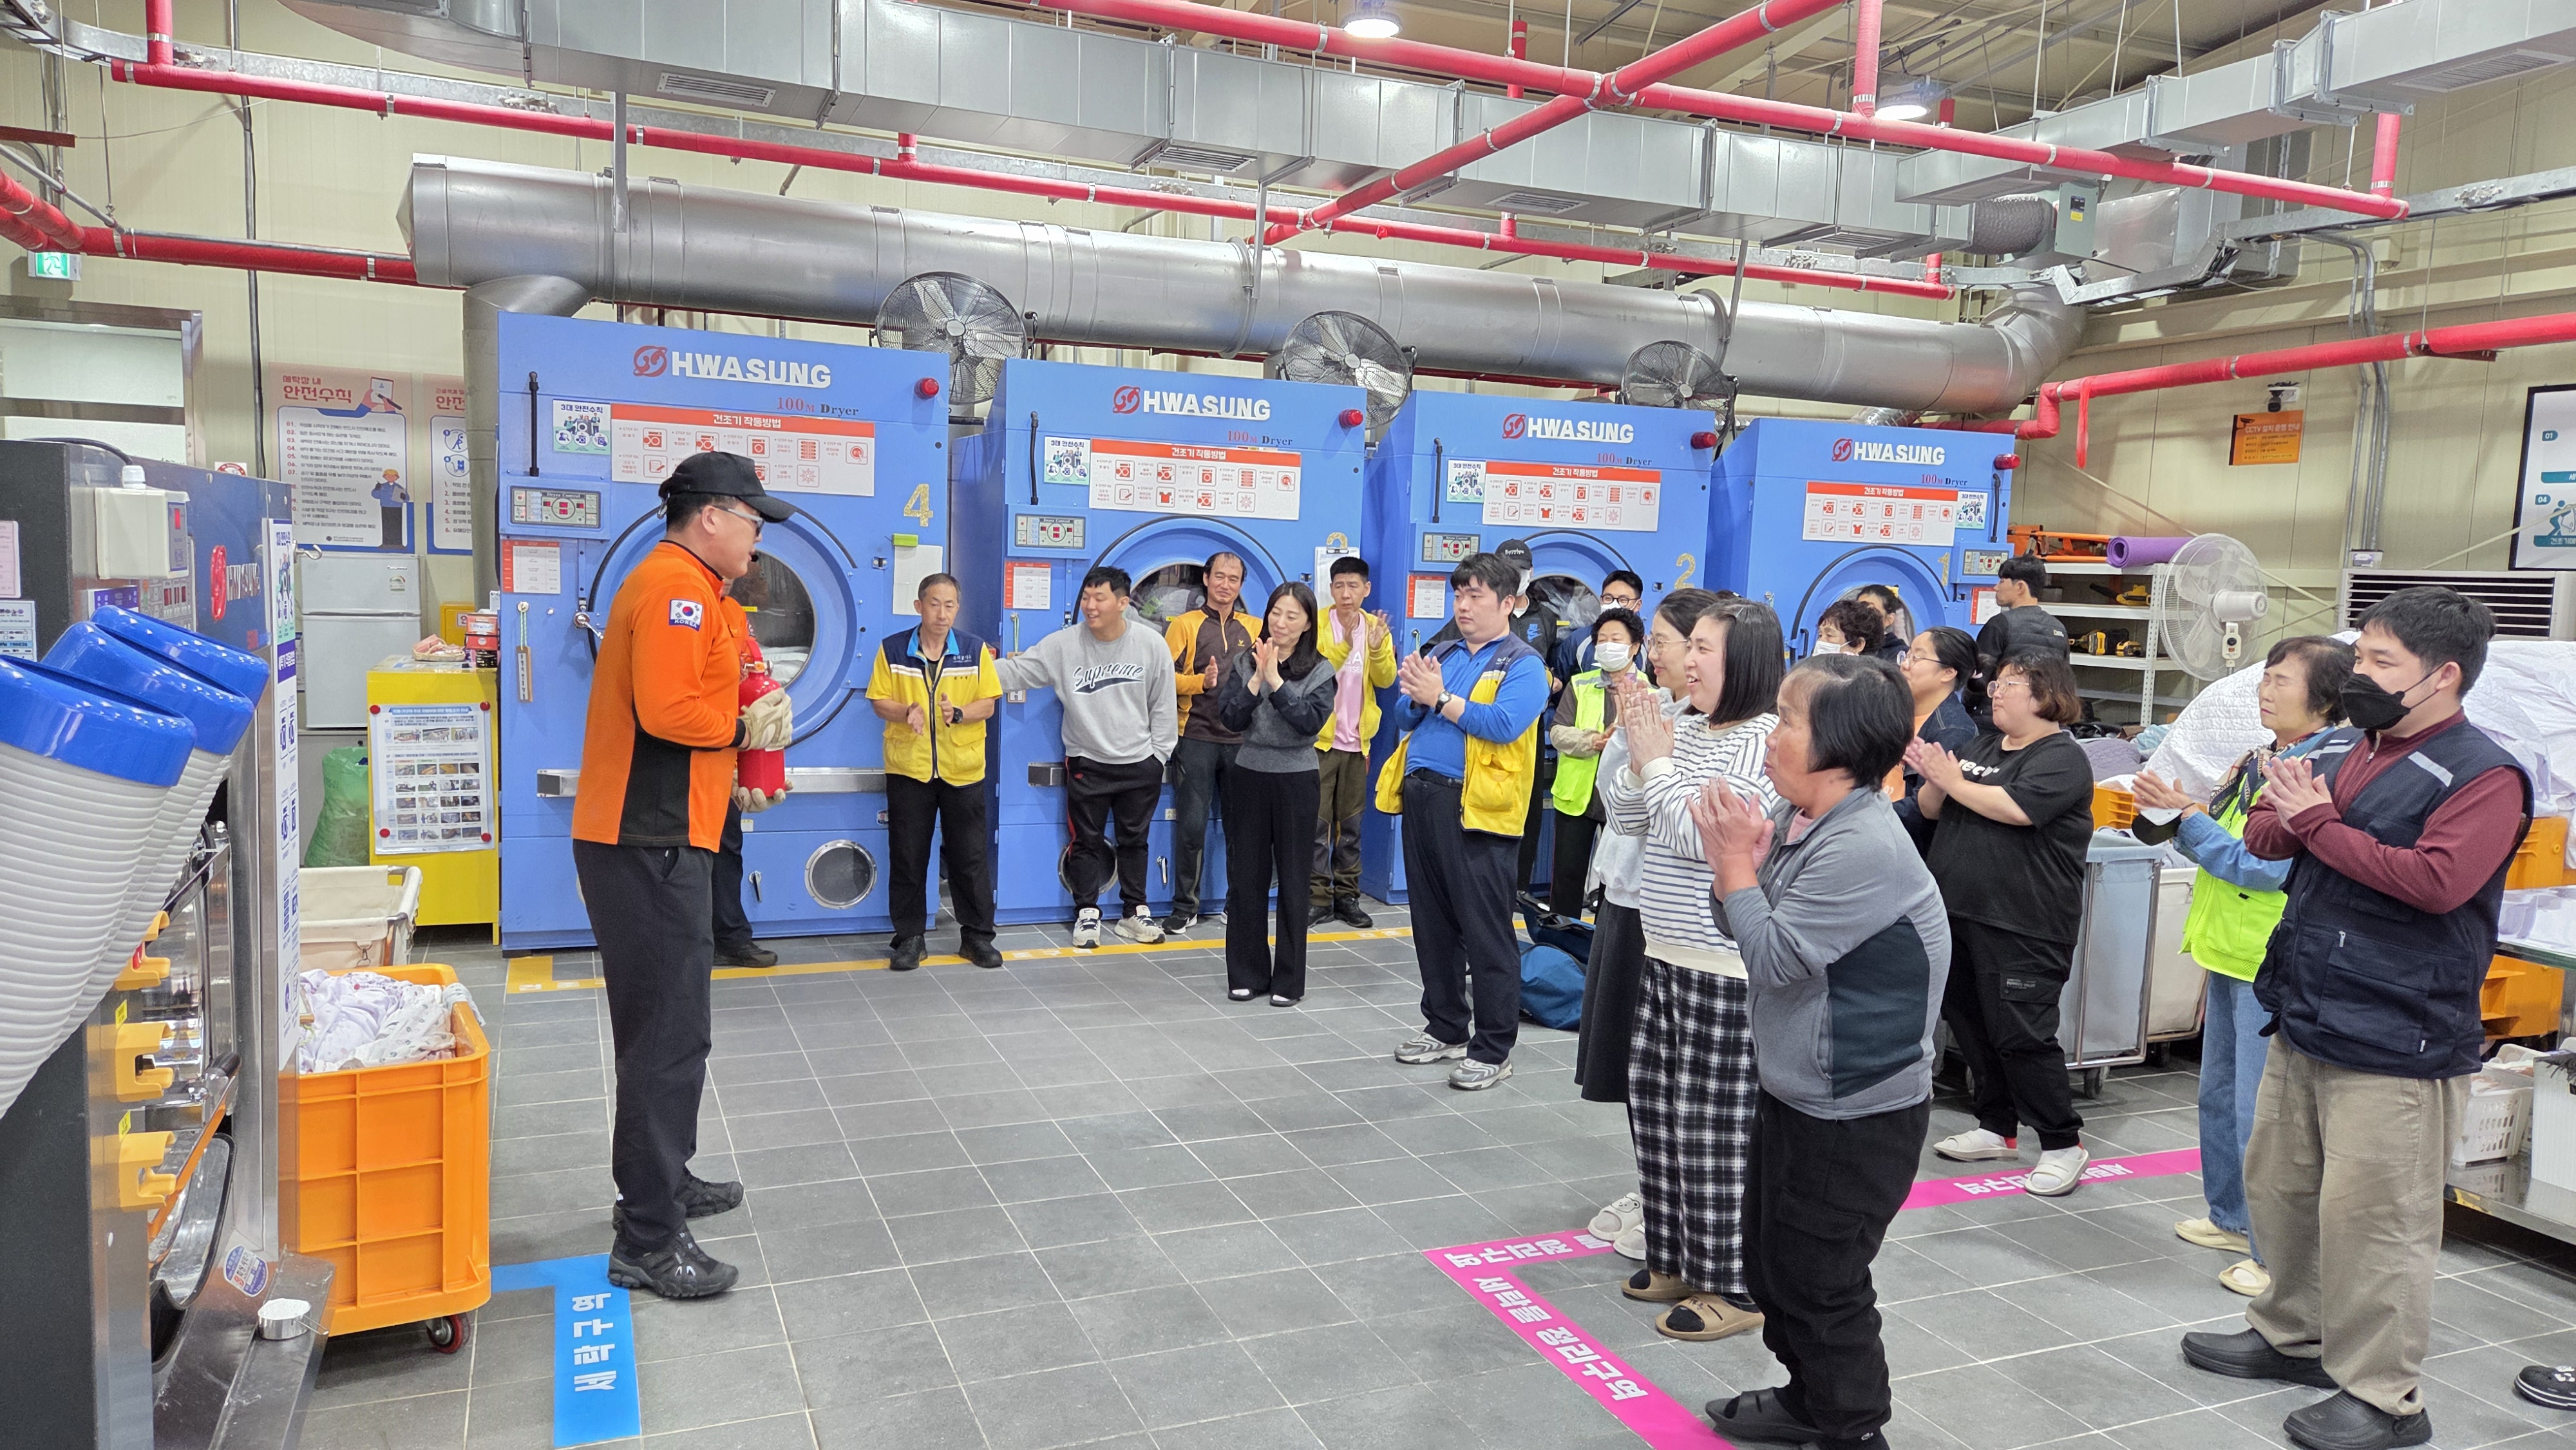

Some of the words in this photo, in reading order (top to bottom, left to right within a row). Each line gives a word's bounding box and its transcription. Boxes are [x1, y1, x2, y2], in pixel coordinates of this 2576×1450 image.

[672, 352, 831, 388] HWASUNG
[283, 385, 352, 403] 안전수칙
[436, 396, 466, 411] 안전
[575, 405, 603, 413] 안전수칙
[820, 404, 859, 418] Dryer
[1144, 390, 1271, 420] HWASUNG
[713, 414, 741, 426] 건조기
[744, 417, 781, 428] 작동방법
[1528, 417, 1634, 443] HWASUNG
[1262, 435, 1293, 447] Dryer
[1171, 447, 1195, 458] 건조기
[1197, 449, 1226, 460] 작동방법
[1626, 457, 1653, 467] Dryer
[1853, 442, 1945, 465] HWASUNG
[1553, 467, 1571, 476] 건조기
[1573, 469, 1598, 478] 작동방법
[1864, 487, 1880, 495] 건조기
[1946, 478, 1968, 488] Dryer
[904, 483, 934, 527] 4
[1674, 553, 1696, 588] 2
[1938, 552, 1951, 585] 1
[674, 619, 697, 628] KOREA
[1074, 663, 1146, 690] Supreme
[1444, 1239, 1573, 1268] 정리구역
[572, 1293, 616, 1392] 세탁구역
[1472, 1277, 1552, 1324] 세탁물
[1536, 1326, 1649, 1401] 정리구역
